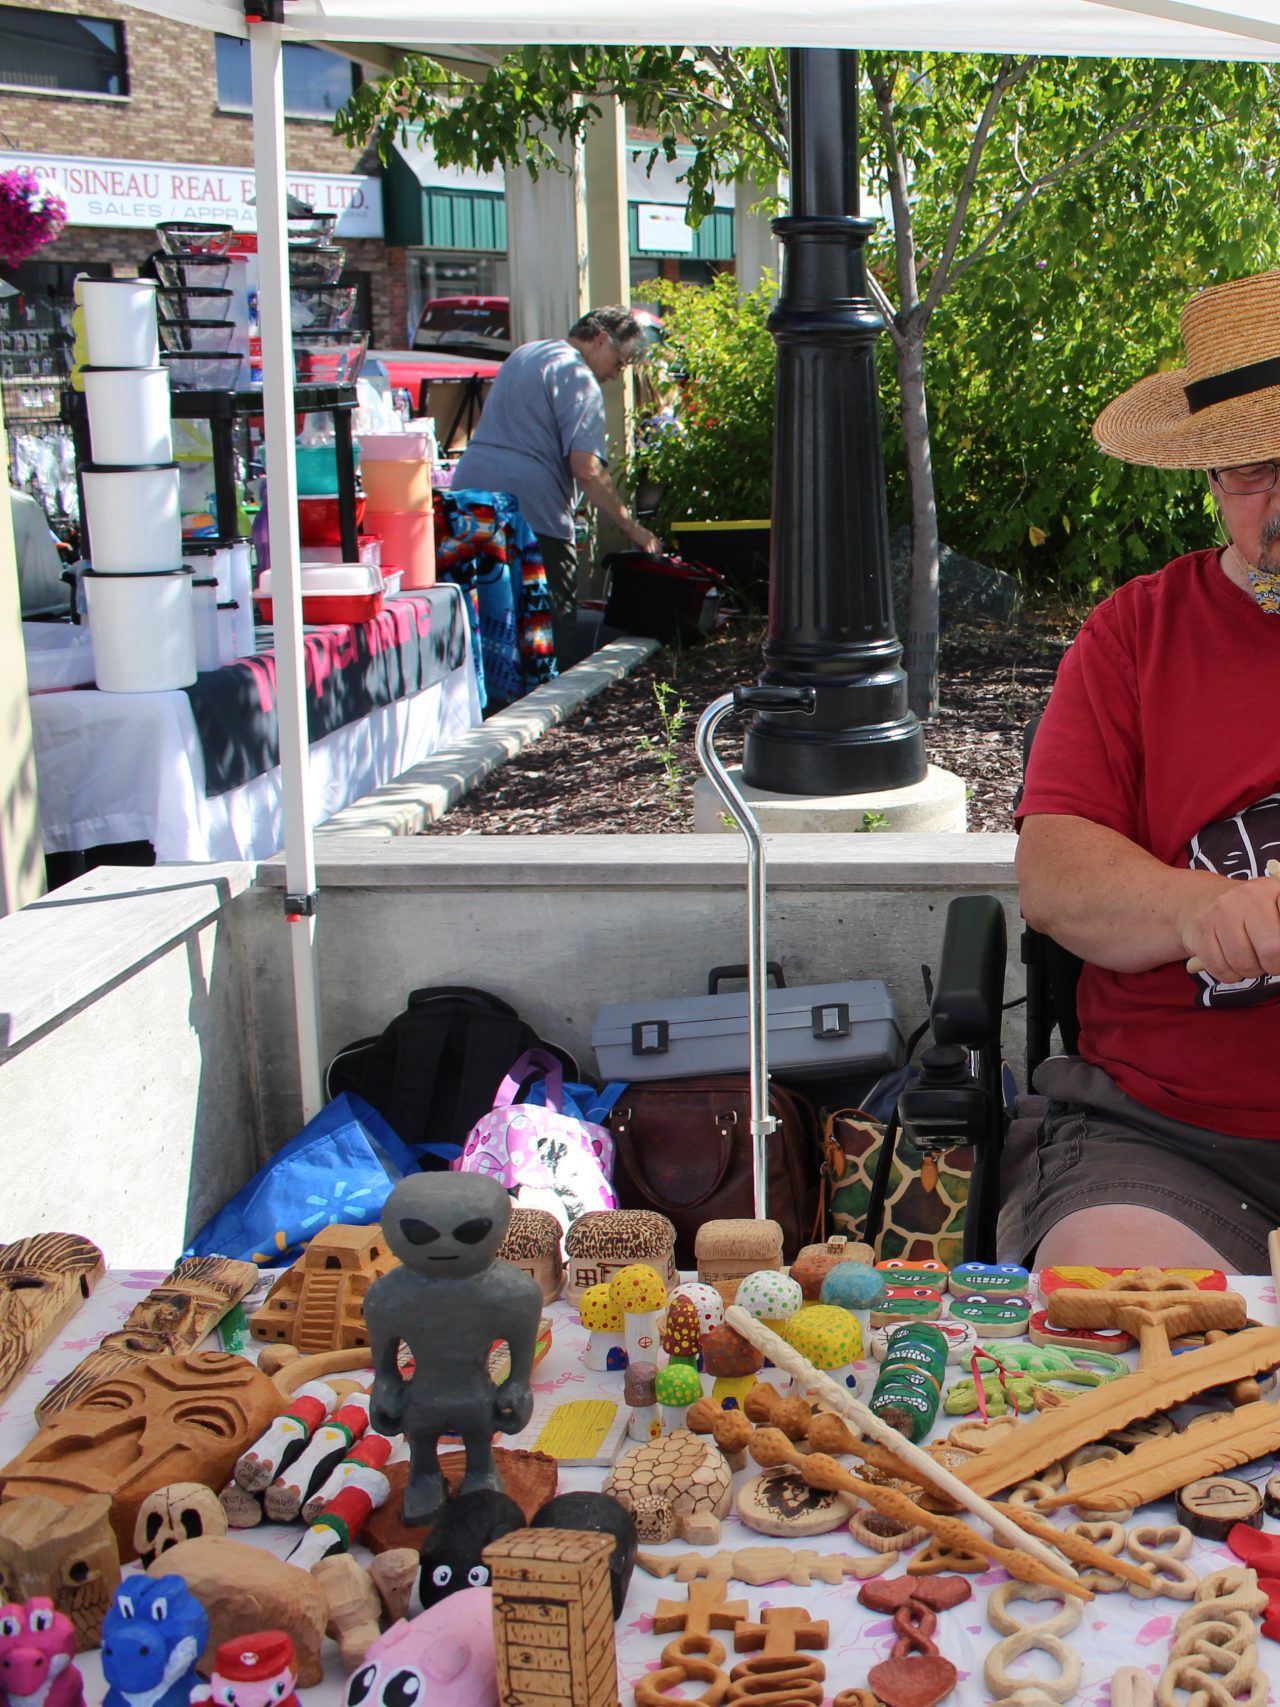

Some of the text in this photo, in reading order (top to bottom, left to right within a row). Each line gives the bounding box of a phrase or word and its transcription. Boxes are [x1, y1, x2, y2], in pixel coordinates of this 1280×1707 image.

[171, 175, 231, 202] REAL
[326, 185, 370, 209] LTD.
[88, 201, 162, 217] SALES
